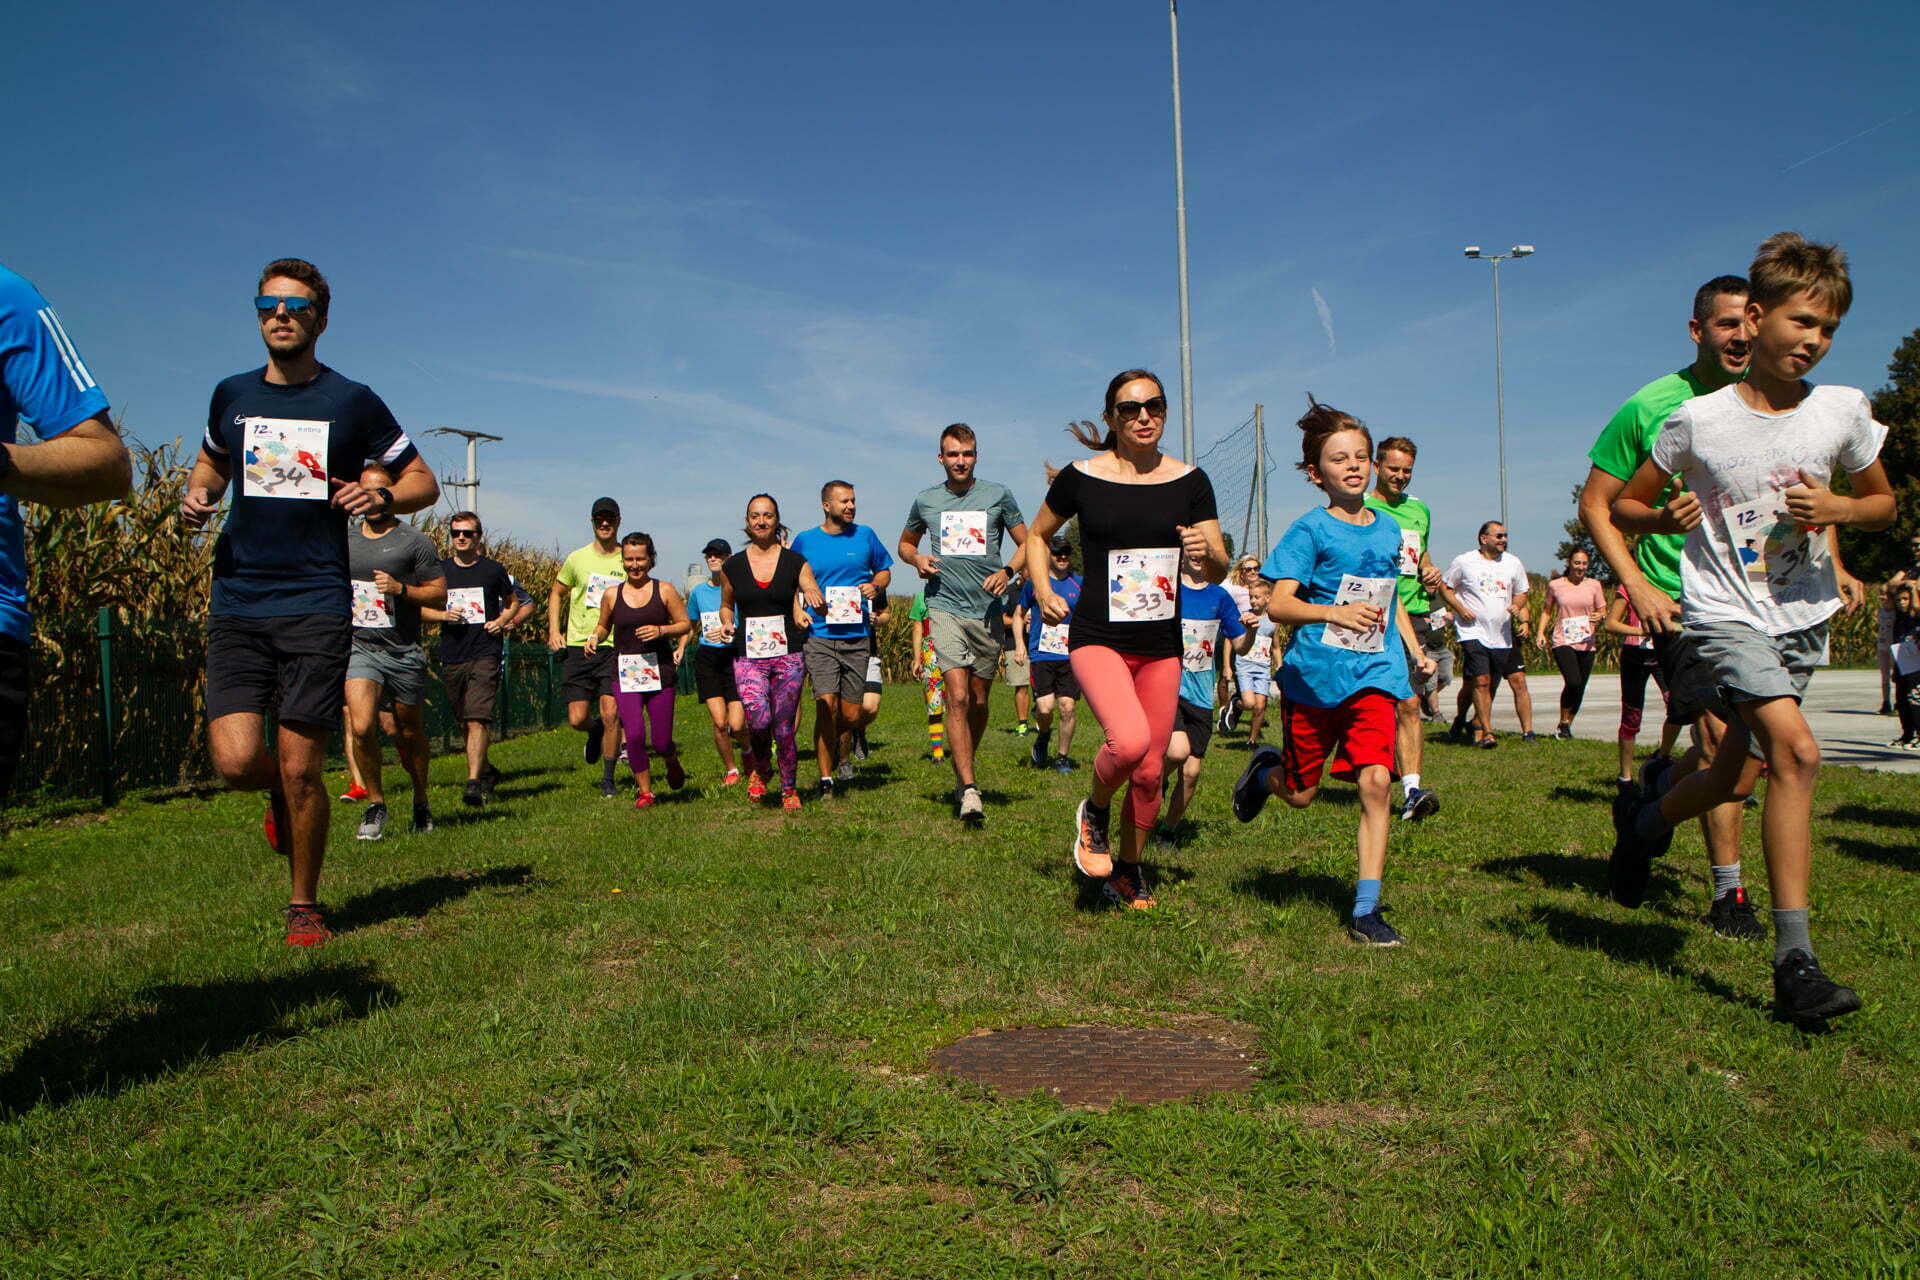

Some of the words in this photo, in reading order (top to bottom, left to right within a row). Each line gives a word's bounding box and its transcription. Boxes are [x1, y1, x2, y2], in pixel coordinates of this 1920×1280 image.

[253, 424, 272, 434] 12.
[268, 466, 306, 487] 34
[1736, 509, 1763, 526] 12.
[957, 537, 972, 549] 14
[1116, 554, 1134, 565] 12.
[1346, 581, 1365, 593] 12.
[1132, 592, 1162, 612] 33
[363, 609, 379, 622] 13
[841, 609, 850, 618] 2
[759, 640, 778, 651] 20
[1182, 650, 1205, 664] 44
[631, 676, 649, 690] 32
